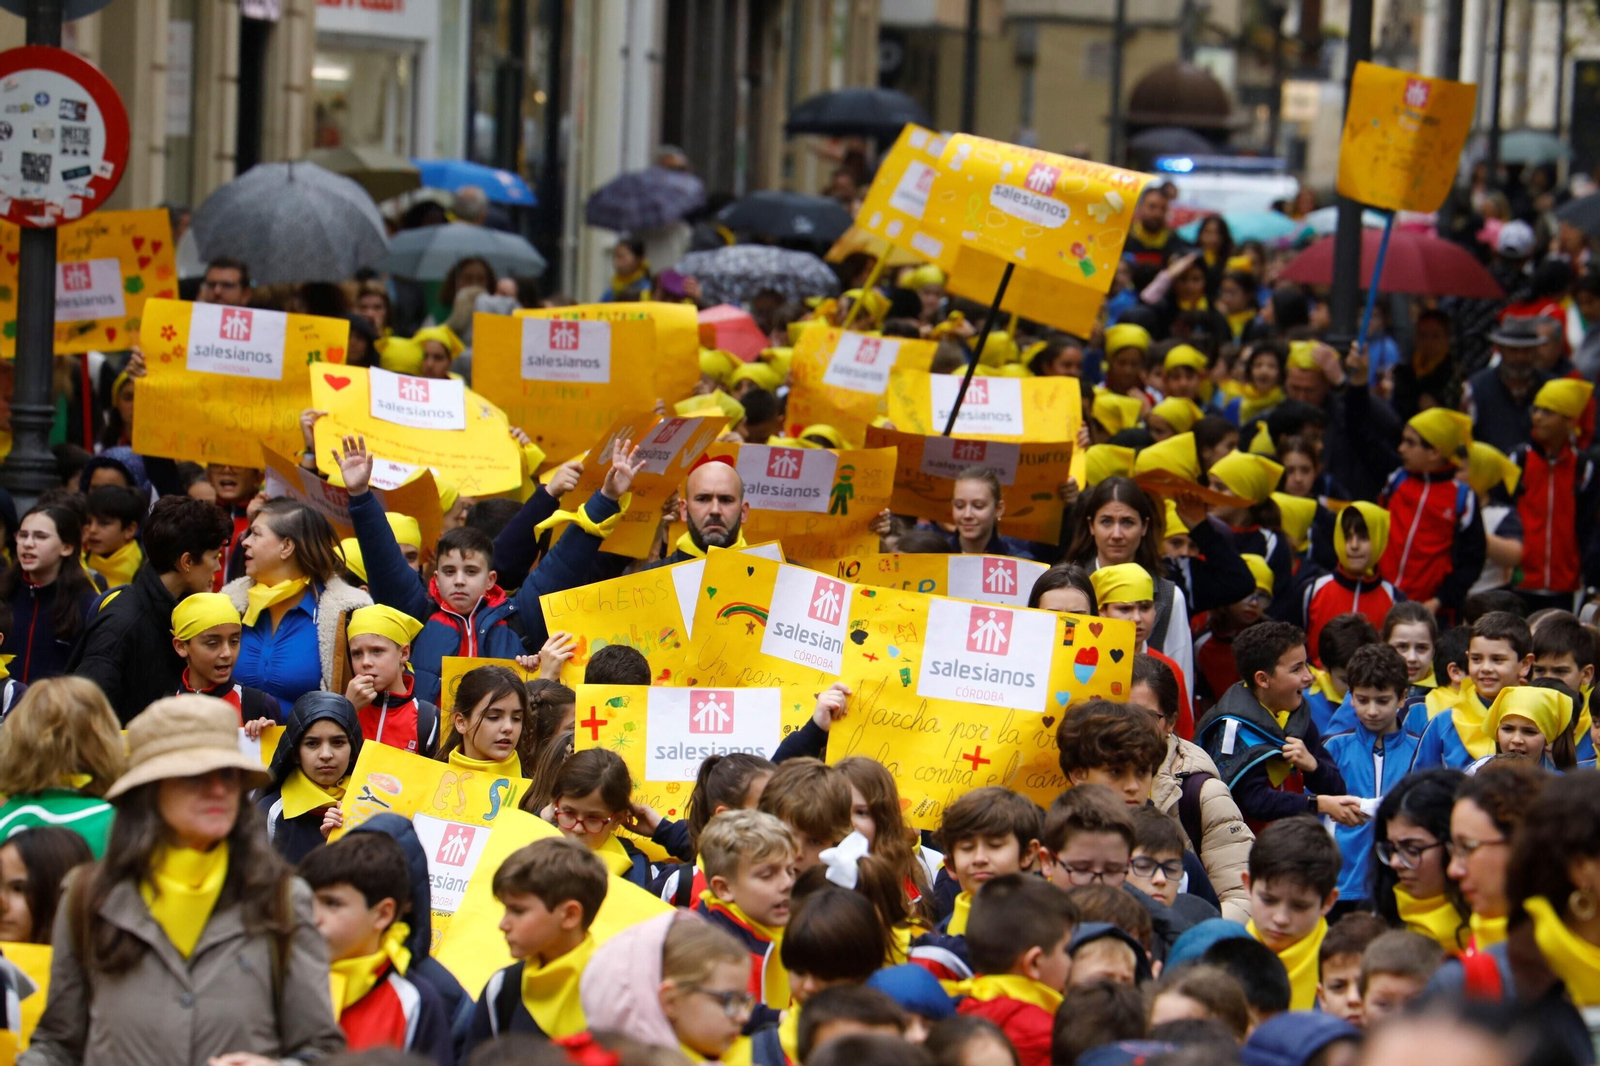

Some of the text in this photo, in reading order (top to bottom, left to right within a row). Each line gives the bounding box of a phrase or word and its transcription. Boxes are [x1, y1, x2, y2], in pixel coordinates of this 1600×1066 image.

[993, 184, 1067, 219] salesianos
[194, 344, 273, 364] salesianos
[526, 354, 601, 369] salesianos
[377, 398, 455, 419] salesianos
[938, 408, 1013, 422] saesianos
[837, 560, 861, 578] NO
[773, 622, 844, 654] salesian
[793, 649, 834, 670] CÓRDOBA
[929, 659, 1036, 687] salesianos
[955, 686, 1005, 703] CÓRDOBA
[850, 676, 941, 733] Marcha
[943, 720, 989, 758] por
[997, 708, 1022, 745] la
[914, 747, 975, 788] contra
